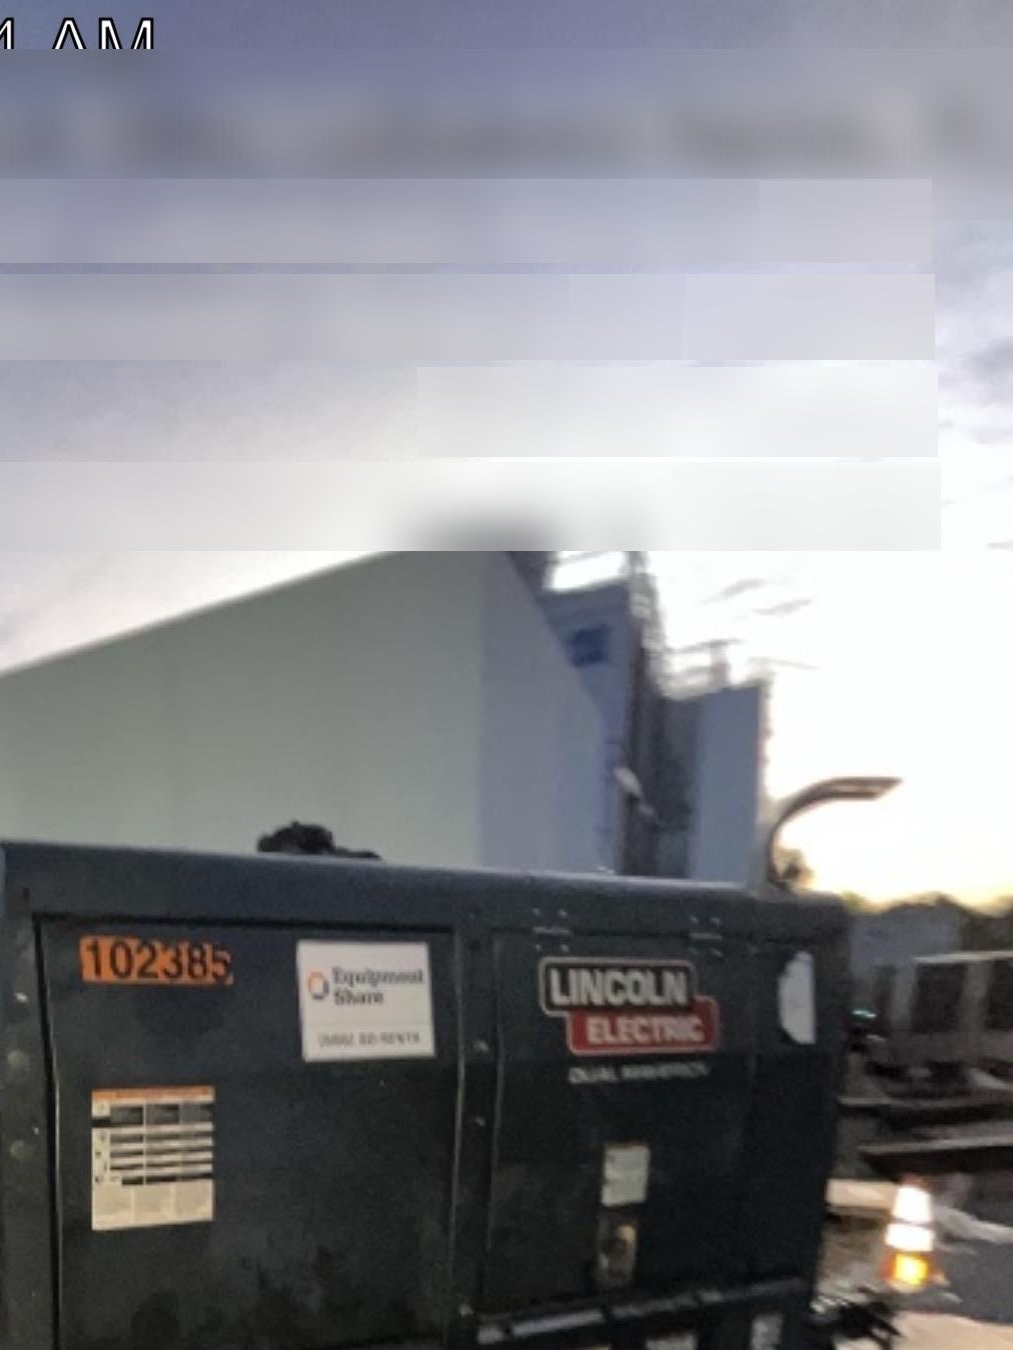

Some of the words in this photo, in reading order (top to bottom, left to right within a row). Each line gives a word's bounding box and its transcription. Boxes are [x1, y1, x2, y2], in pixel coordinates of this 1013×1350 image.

[86, 939, 229, 980] 102385
[332, 967, 424, 987] Equipment
[549, 967, 689, 1006] LINCOLN
[587, 1013, 706, 1045] ELECTRIC
